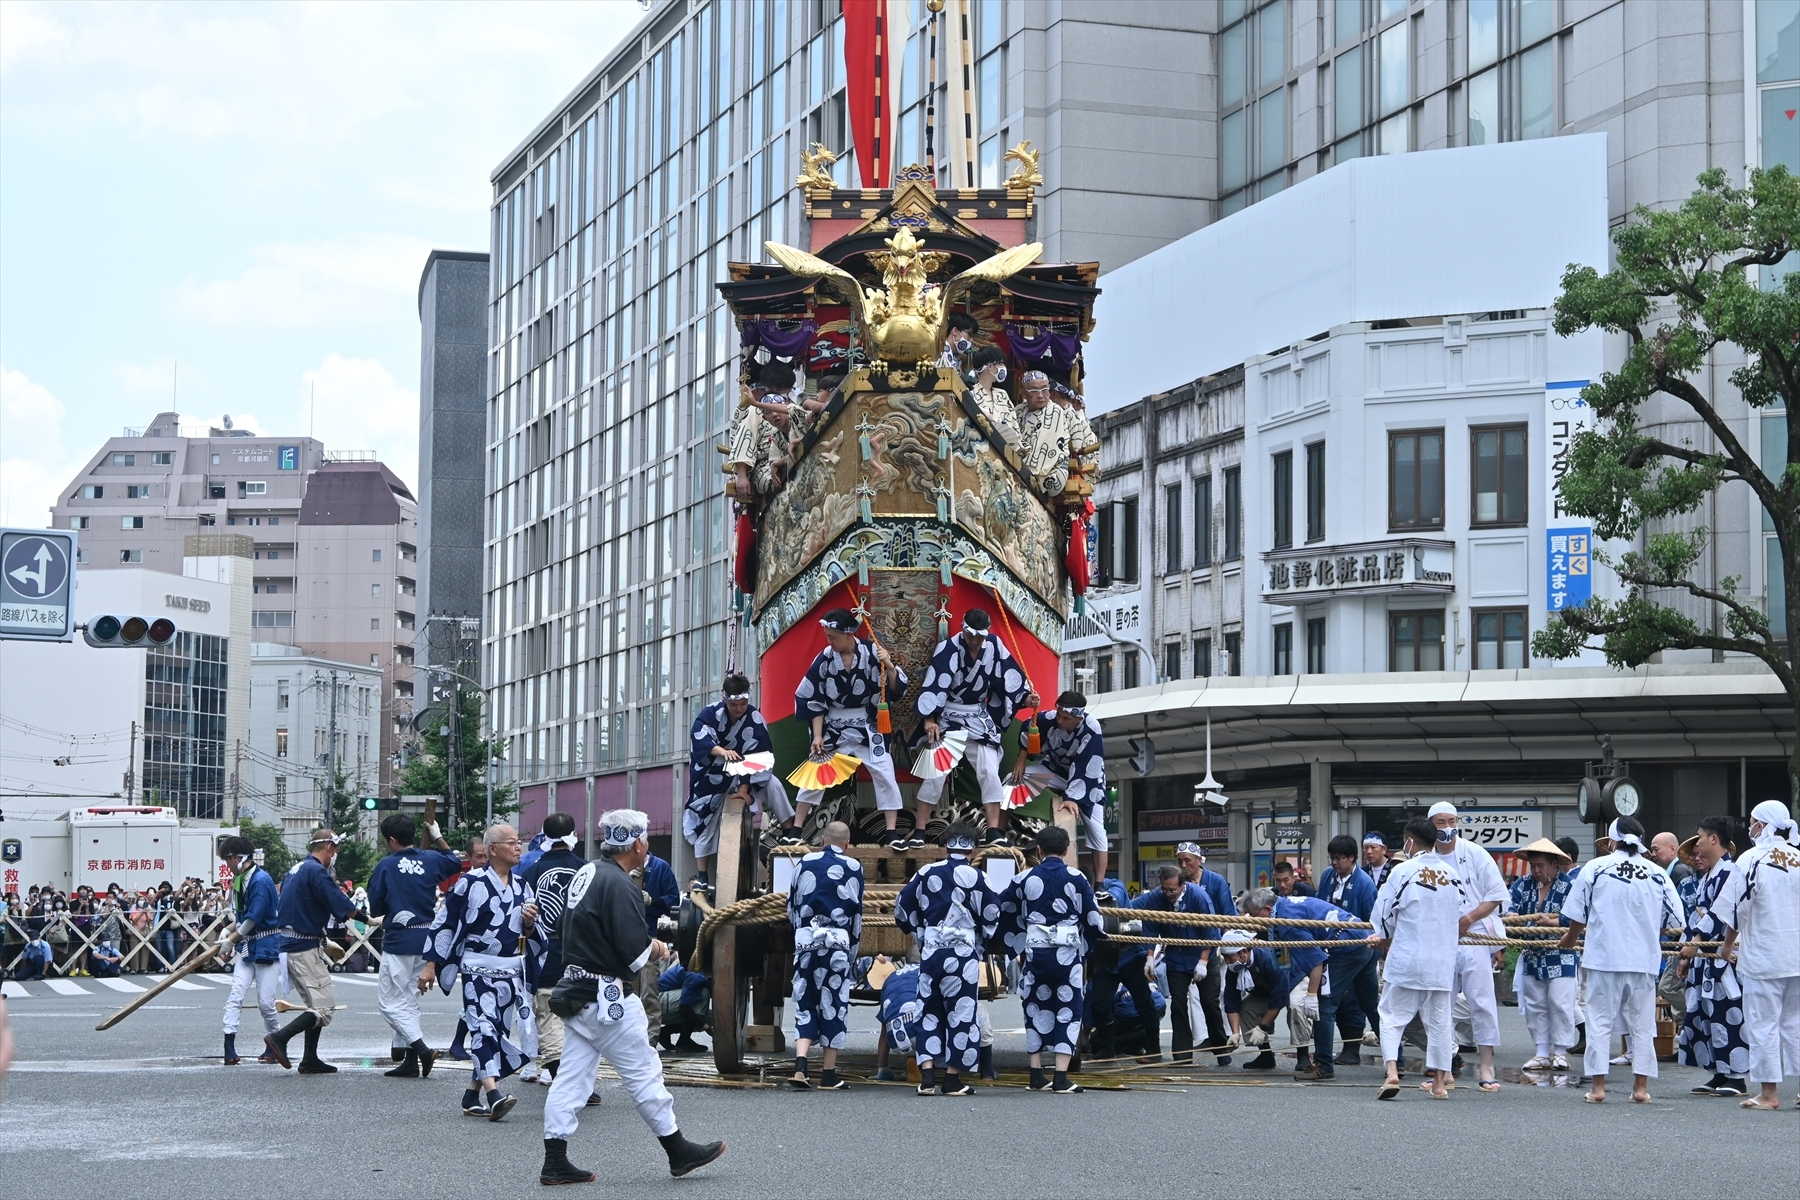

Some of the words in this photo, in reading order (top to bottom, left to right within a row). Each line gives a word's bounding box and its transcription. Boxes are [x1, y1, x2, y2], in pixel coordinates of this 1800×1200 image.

[237, 455, 269, 463] 京都河原町
[1551, 421, 1570, 519] コンタト
[1570, 536, 1585, 573] すぐ
[1269, 552, 1404, 590] 池善化粧品店
[1550, 535, 1567, 608] 買えます
[1, 608, 65, 624] 路線バスを除く
[1115, 604, 1139, 631] 雲の茶
[1474, 815, 1529, 824] メガネスーパー
[87, 859, 165, 871] 京都市消防局
